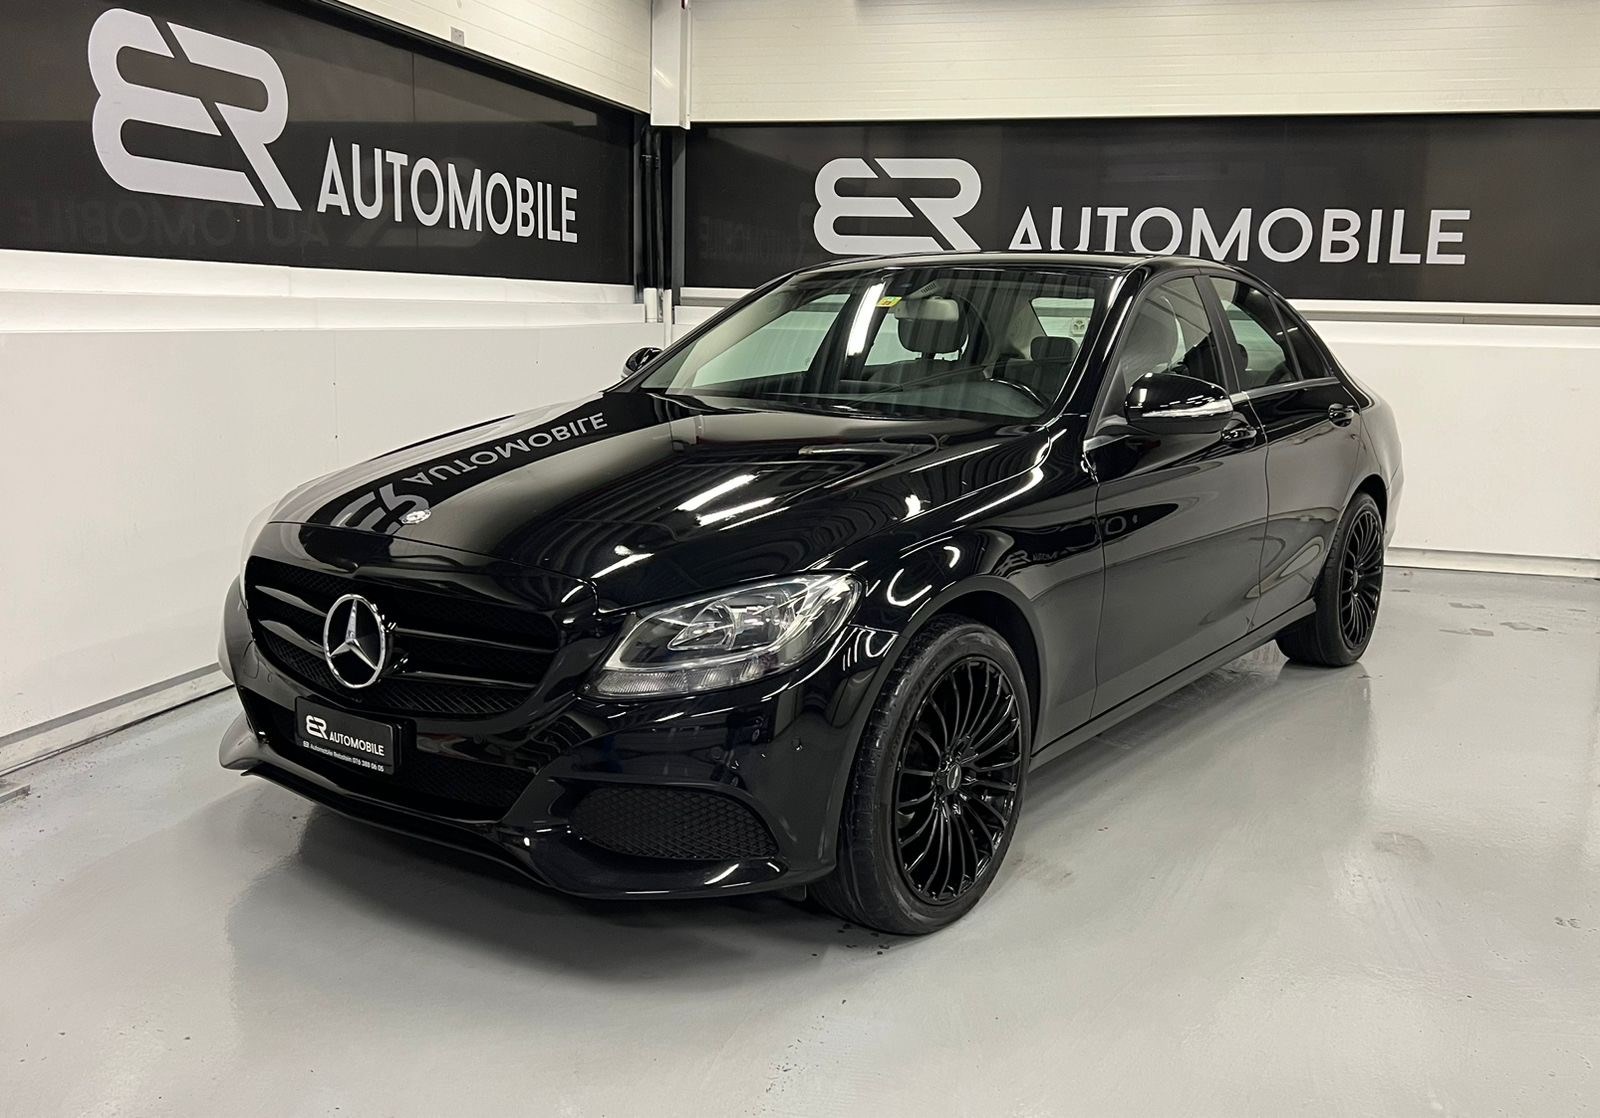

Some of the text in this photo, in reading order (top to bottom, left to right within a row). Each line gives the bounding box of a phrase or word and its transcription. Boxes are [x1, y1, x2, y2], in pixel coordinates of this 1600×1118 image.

[316, 137, 579, 244] AUTOMOBILE
[1008, 205, 1472, 265] AUTOMOBILE
[329, 731, 385, 757] AUTOMOBILE
